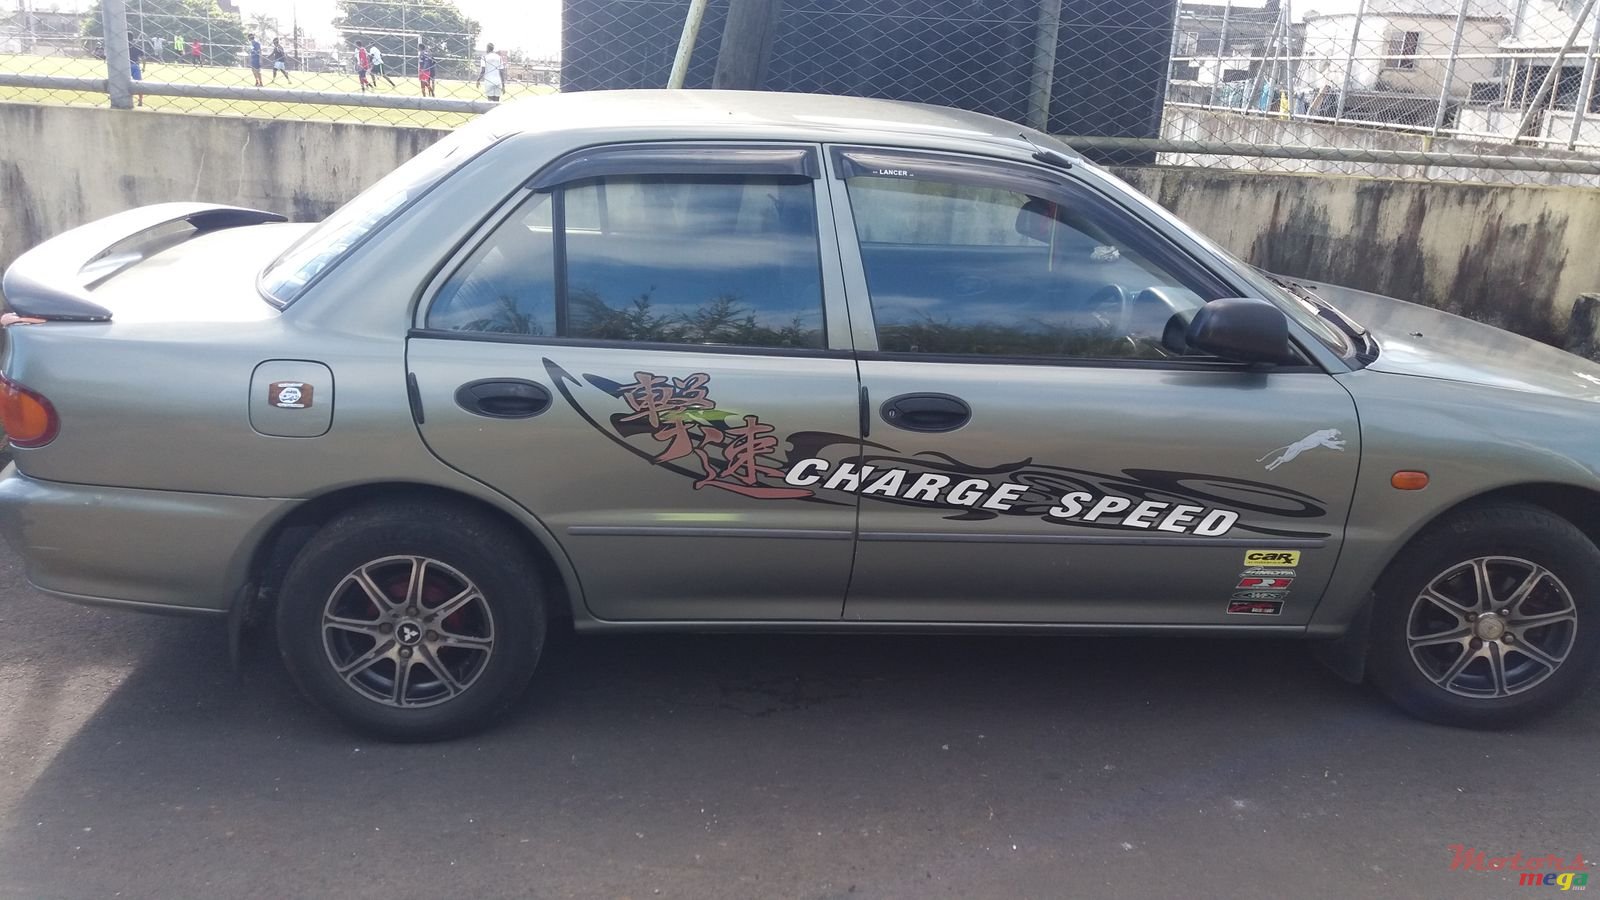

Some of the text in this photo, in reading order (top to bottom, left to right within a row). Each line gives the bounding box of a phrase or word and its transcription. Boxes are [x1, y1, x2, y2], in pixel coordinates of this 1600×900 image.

[879, 169, 908, 177] LANCER
[784, 457, 1240, 537] CHARGE SPEED
